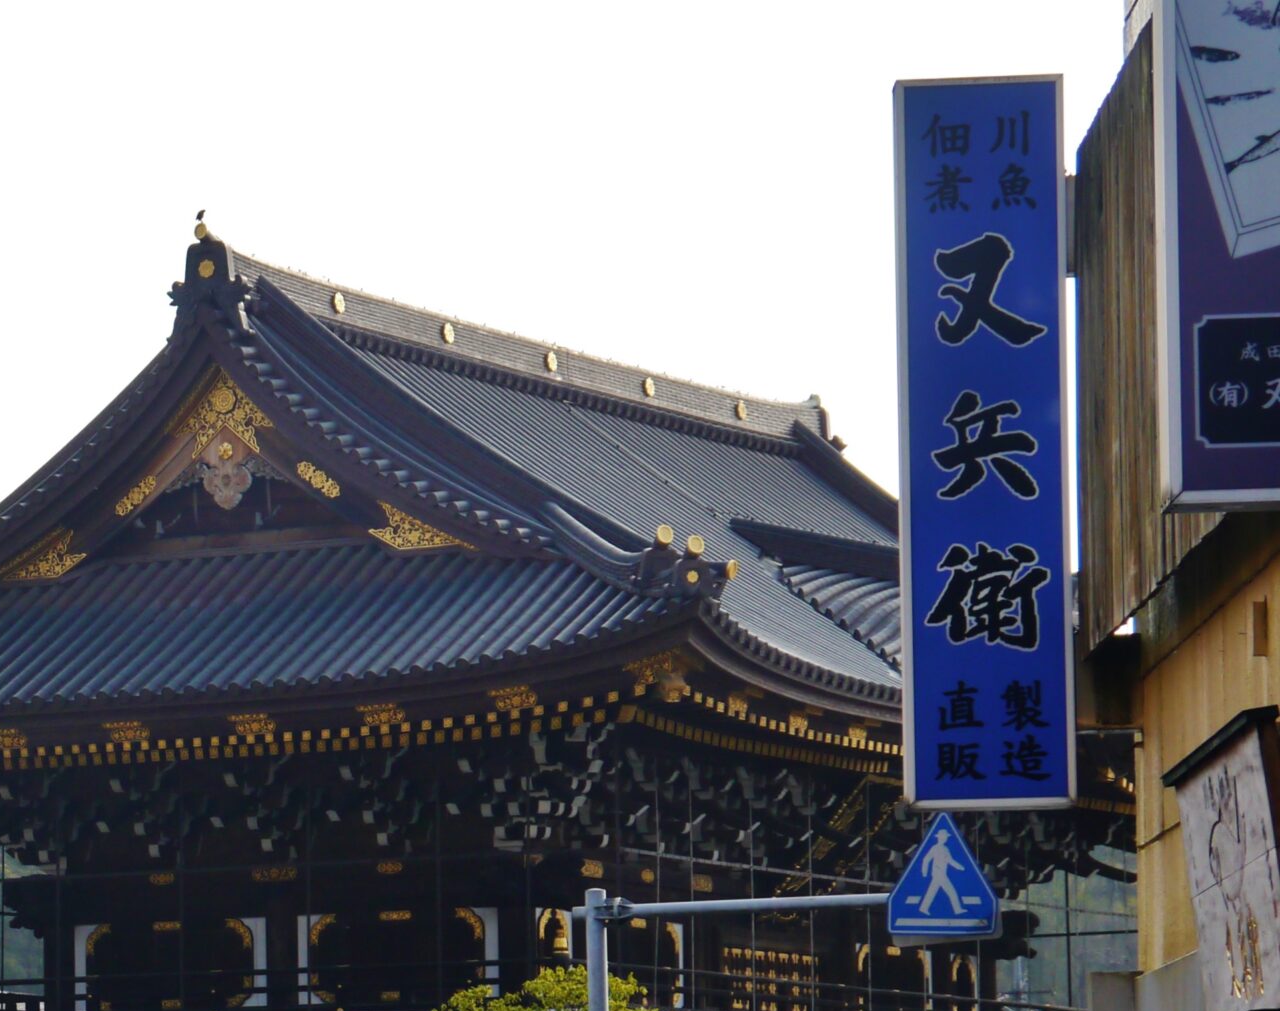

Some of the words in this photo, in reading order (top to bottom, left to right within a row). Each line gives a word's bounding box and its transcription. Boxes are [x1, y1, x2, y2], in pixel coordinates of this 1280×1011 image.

[921, 113, 973, 214] 佃煮
[990, 110, 1037, 210] 川魚
[935, 681, 988, 782] 直販
[999, 680, 1054, 782] 製造
